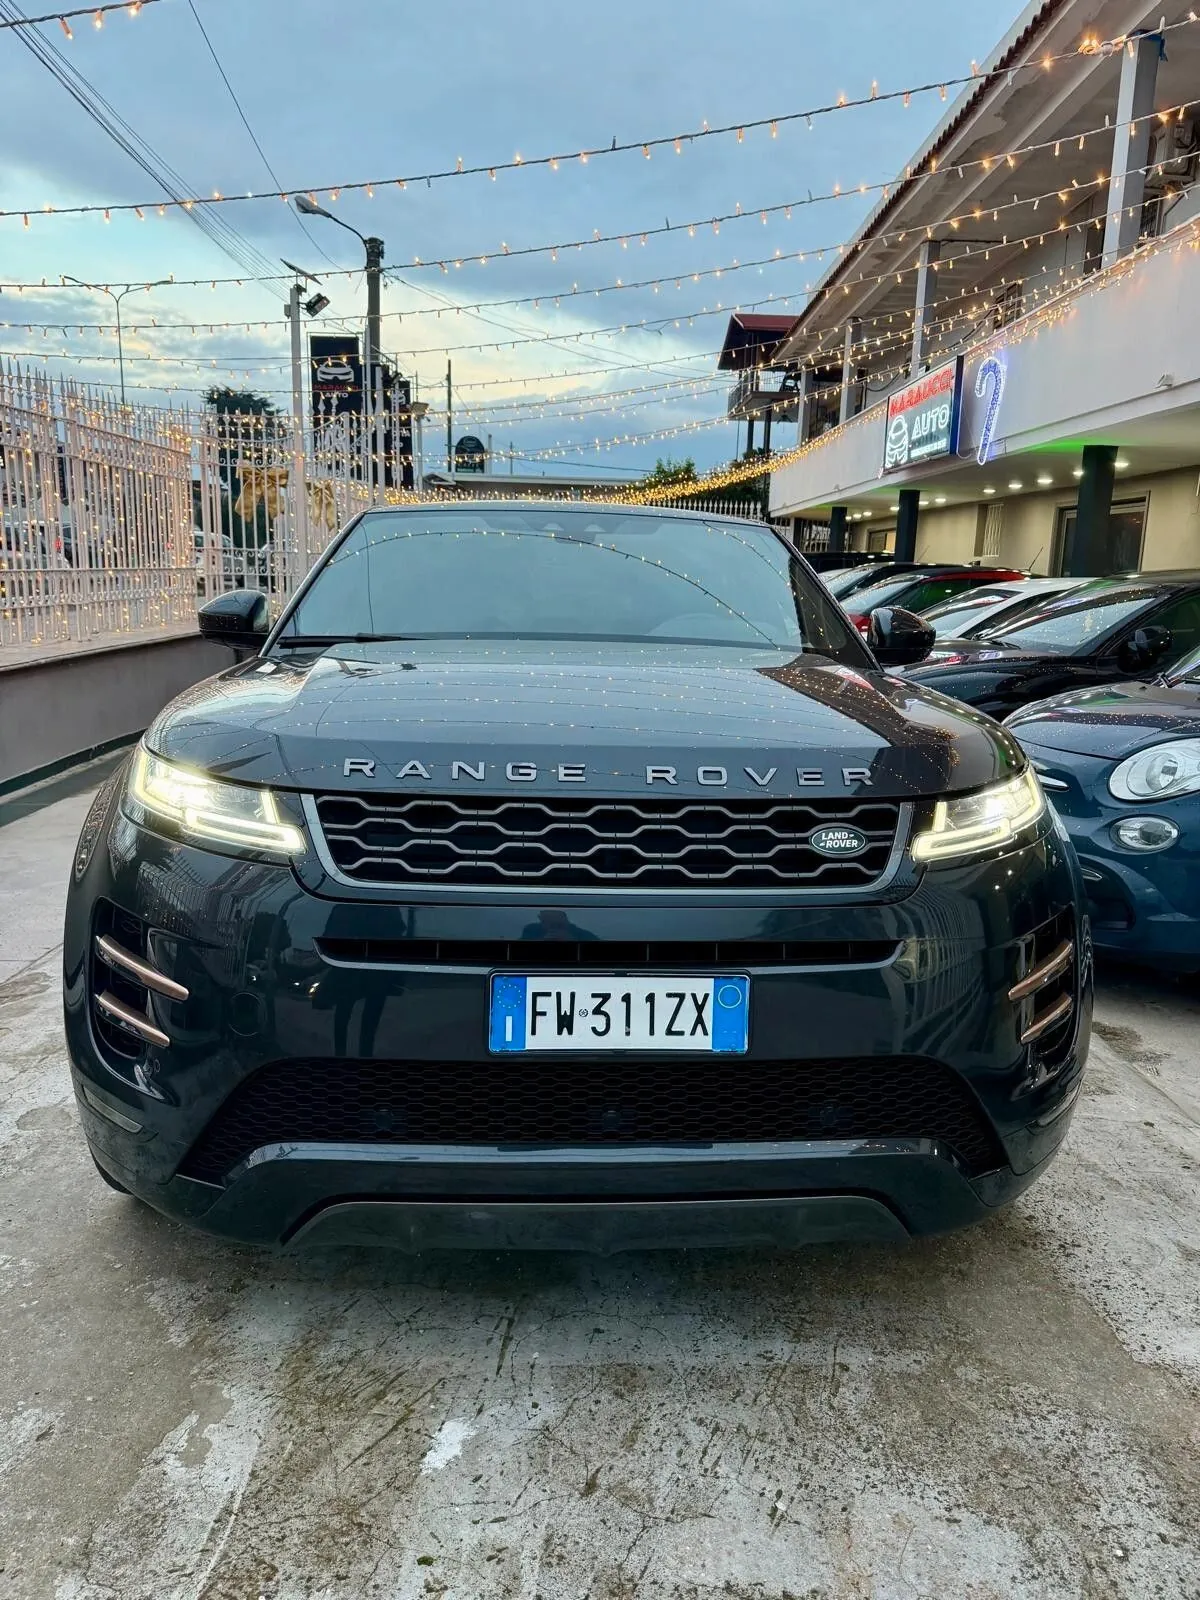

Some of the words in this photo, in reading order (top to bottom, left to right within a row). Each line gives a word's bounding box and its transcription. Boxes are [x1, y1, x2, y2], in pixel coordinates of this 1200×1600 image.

[911, 404, 950, 440] AUTO
[343, 758, 586, 782] RANGE
[645, 765, 873, 786] ROVER
[821, 831, 849, 841] LAND
[825, 839, 858, 849] ROVER
